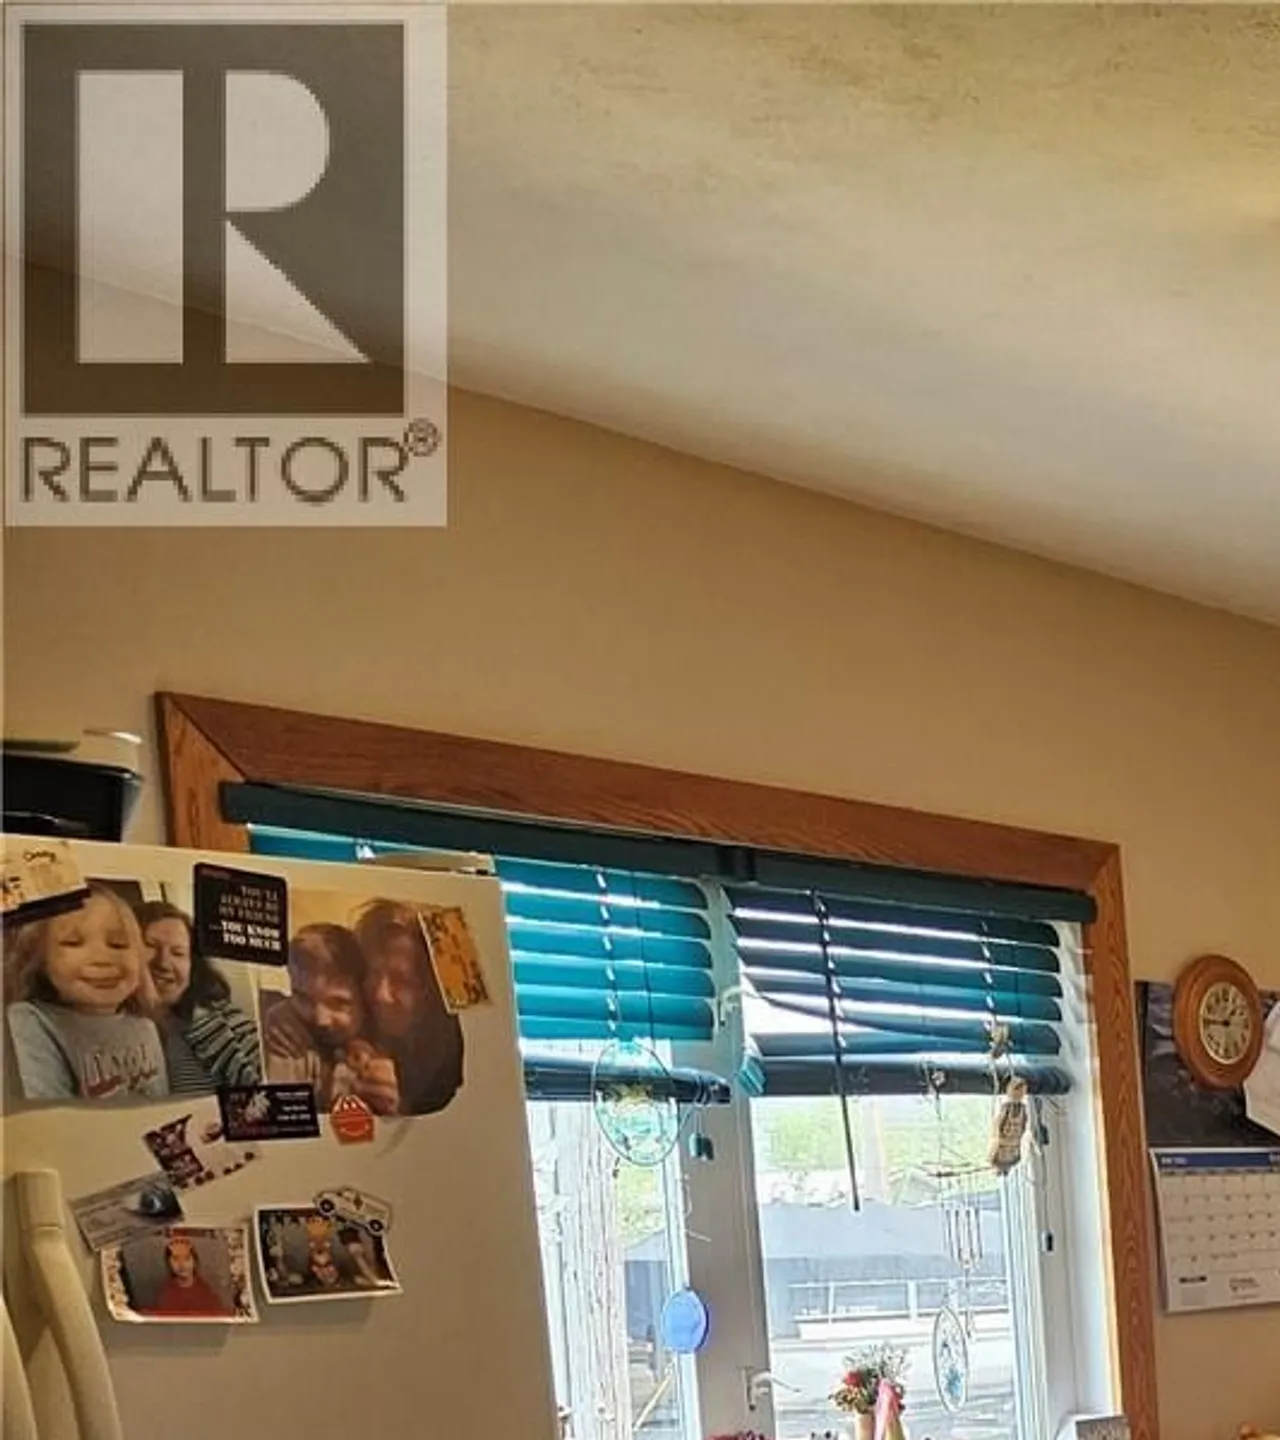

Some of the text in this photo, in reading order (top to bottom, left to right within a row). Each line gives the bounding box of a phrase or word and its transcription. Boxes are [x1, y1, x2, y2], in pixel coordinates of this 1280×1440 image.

[246, 923, 280, 938] KNOW
[223, 932, 281, 951] TOO MUCH
